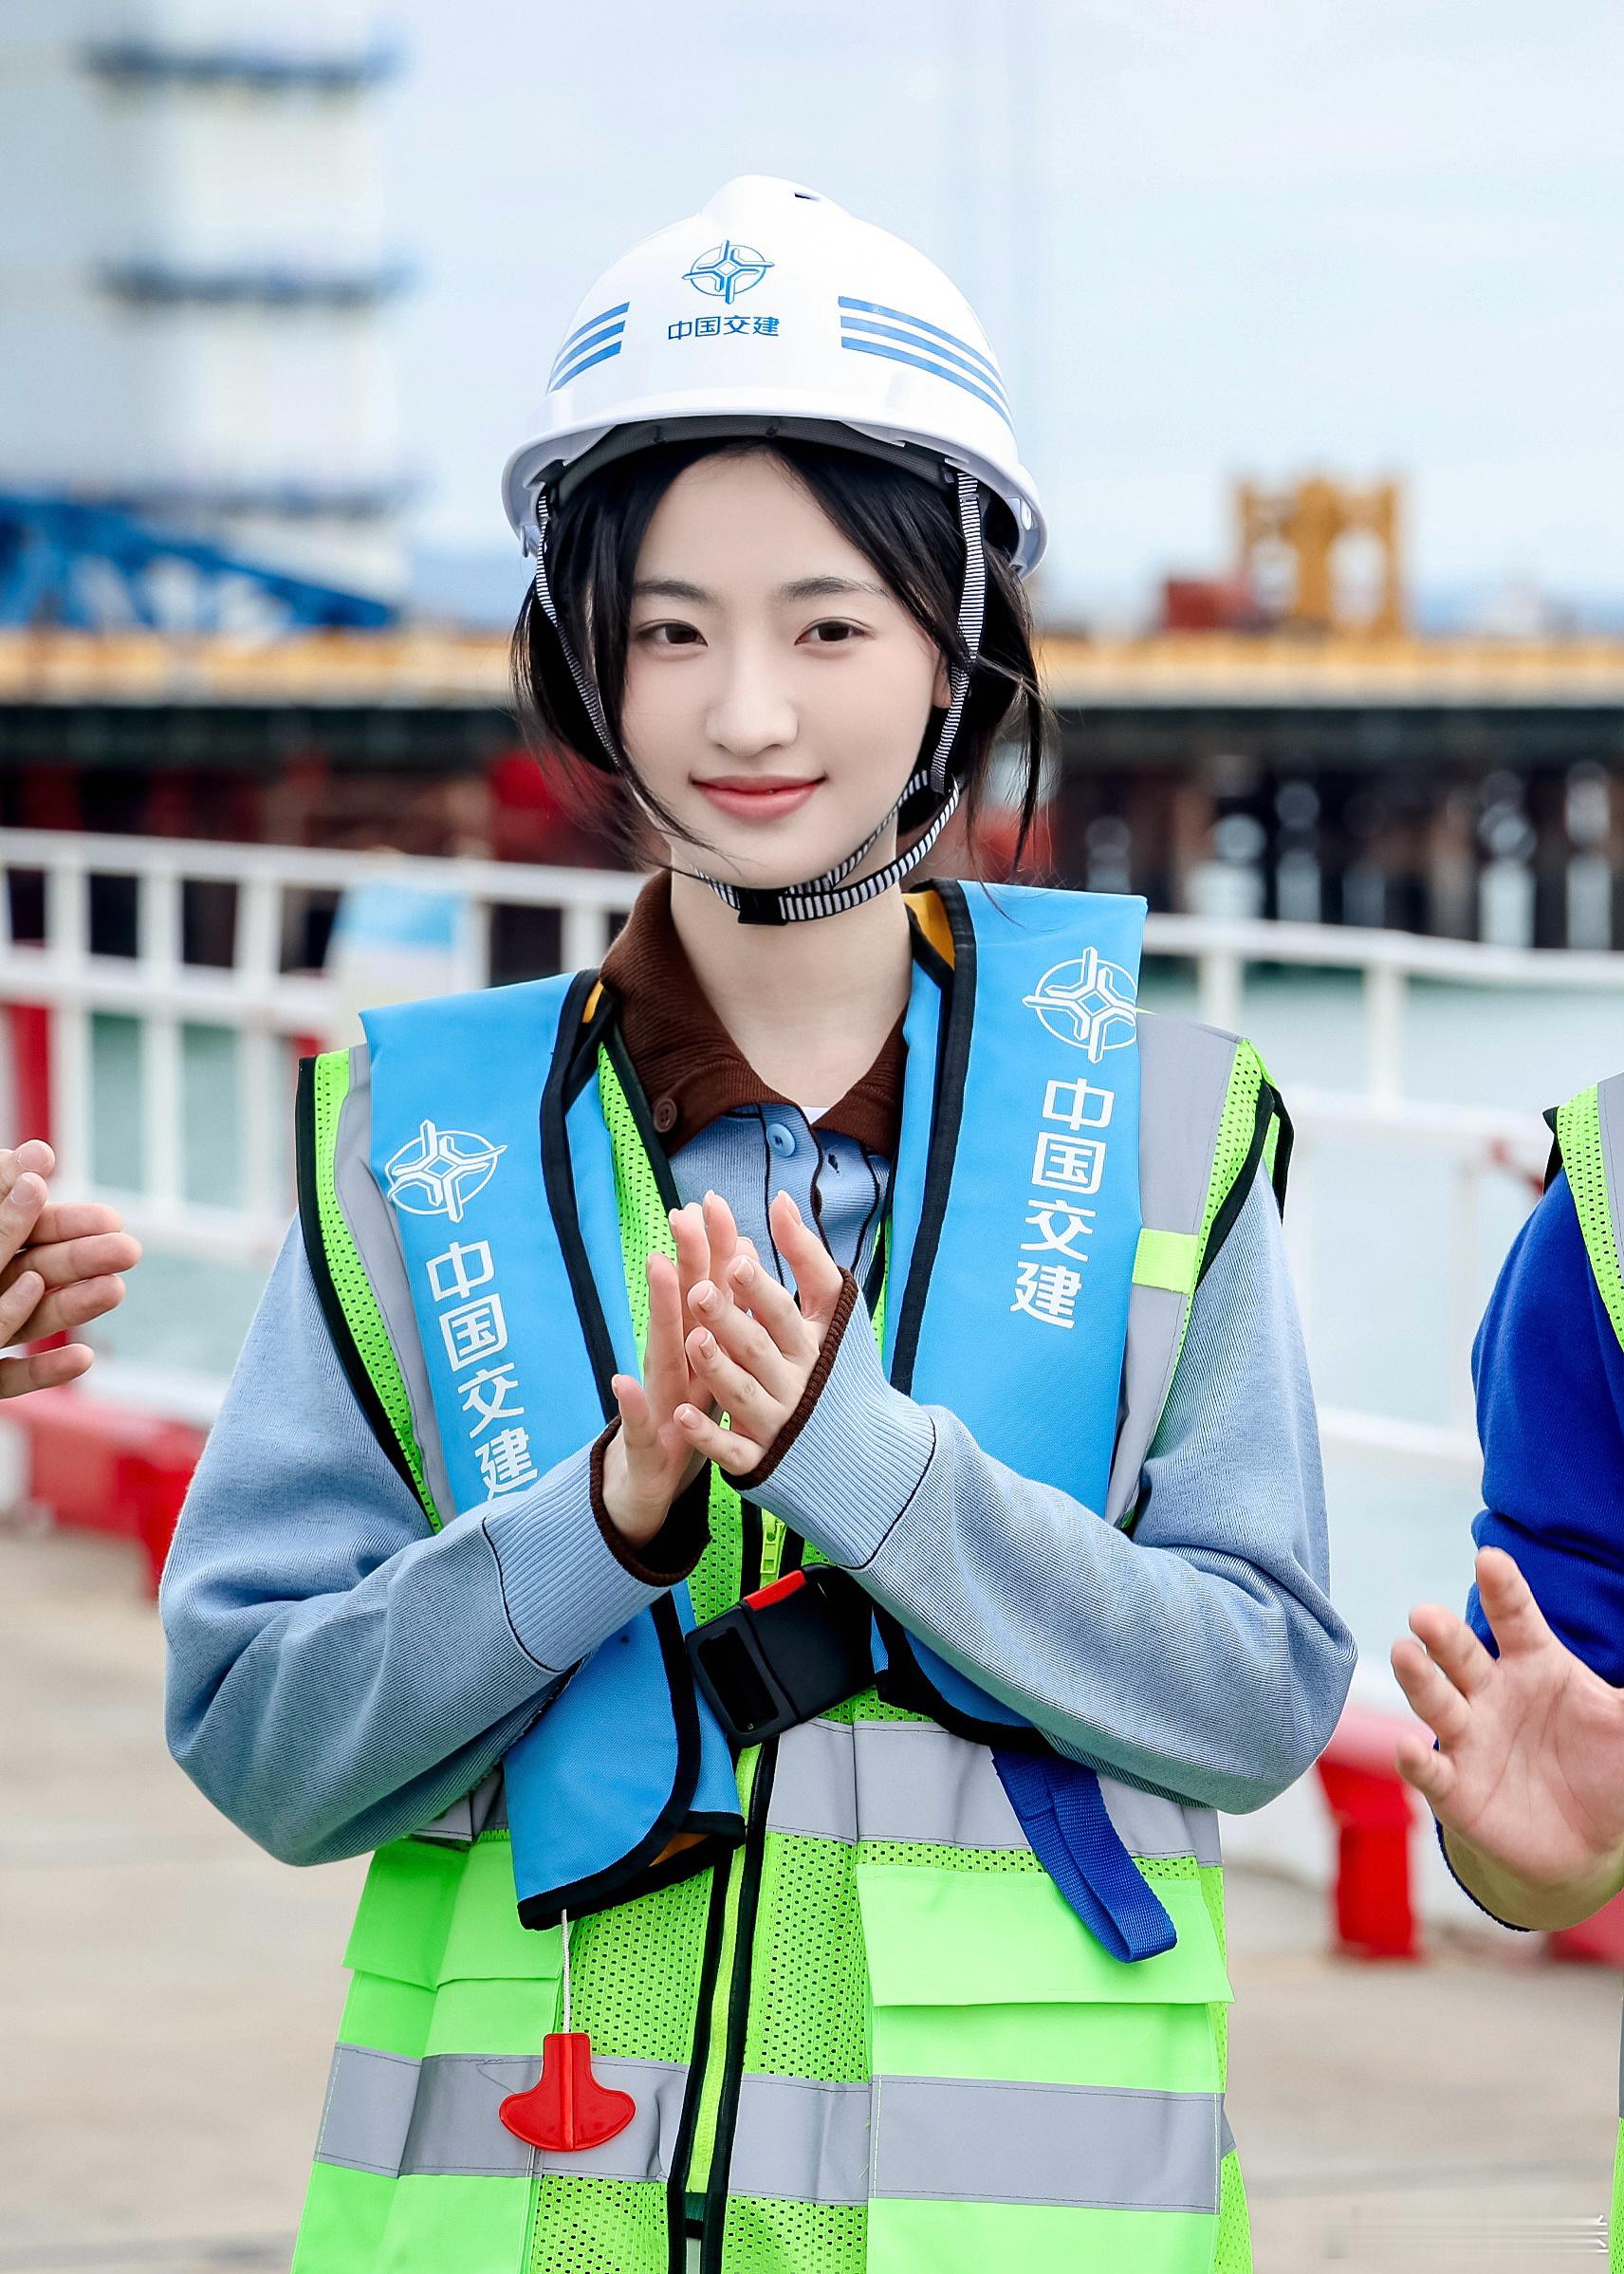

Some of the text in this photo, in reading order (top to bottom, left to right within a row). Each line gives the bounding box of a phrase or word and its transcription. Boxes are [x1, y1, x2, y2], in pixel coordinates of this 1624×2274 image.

[668, 315, 780, 340] 中国交建
[1009, 1077, 1116, 1329] 中国交建
[425, 1239, 539, 1500] 中国交建
